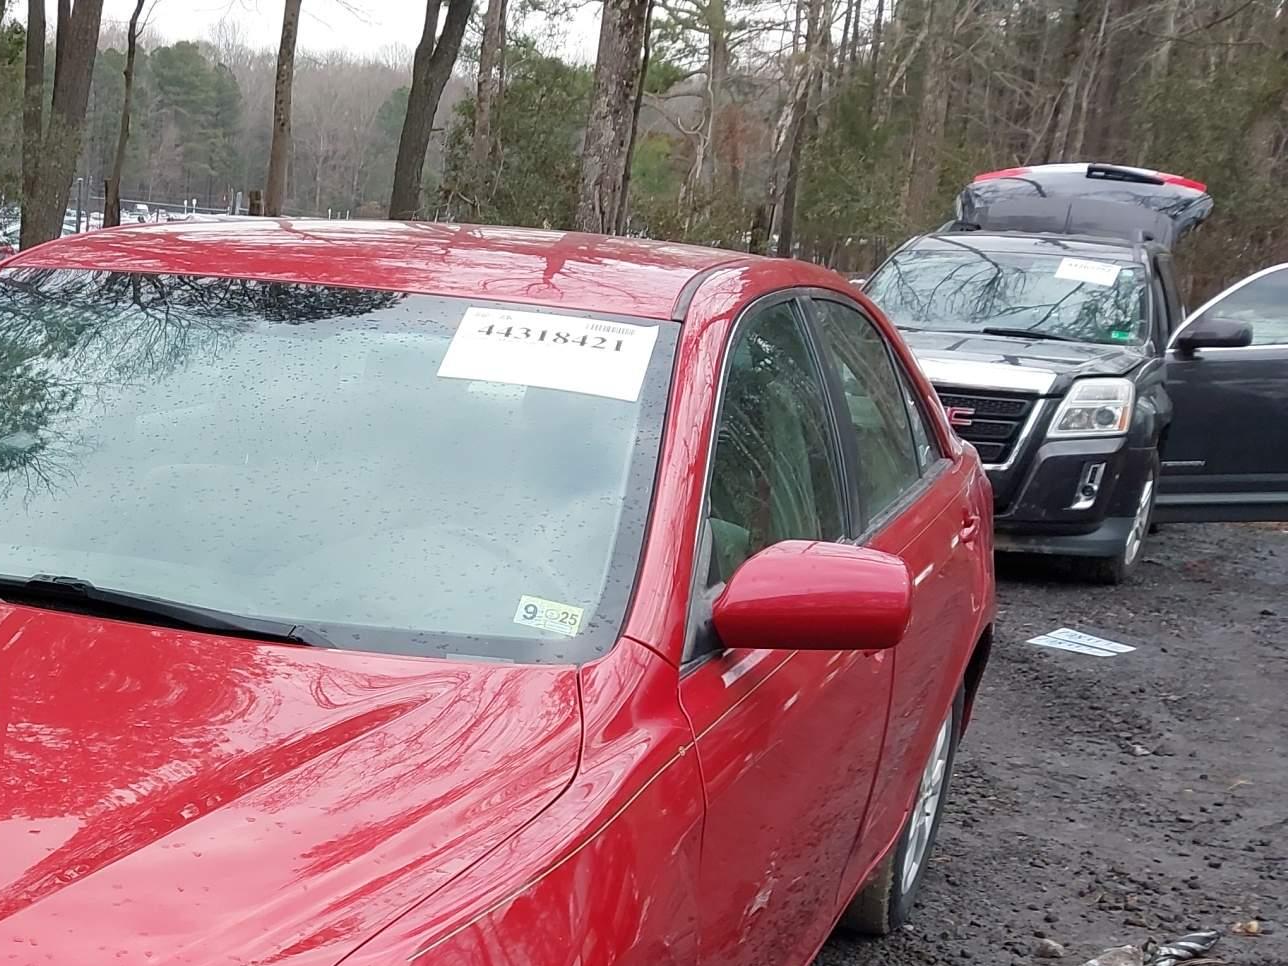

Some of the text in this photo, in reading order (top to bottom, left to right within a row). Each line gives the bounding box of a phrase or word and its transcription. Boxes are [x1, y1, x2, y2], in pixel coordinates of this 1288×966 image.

[478, 324, 623, 352] 44318421
[522, 603, 579, 626] 9 25
